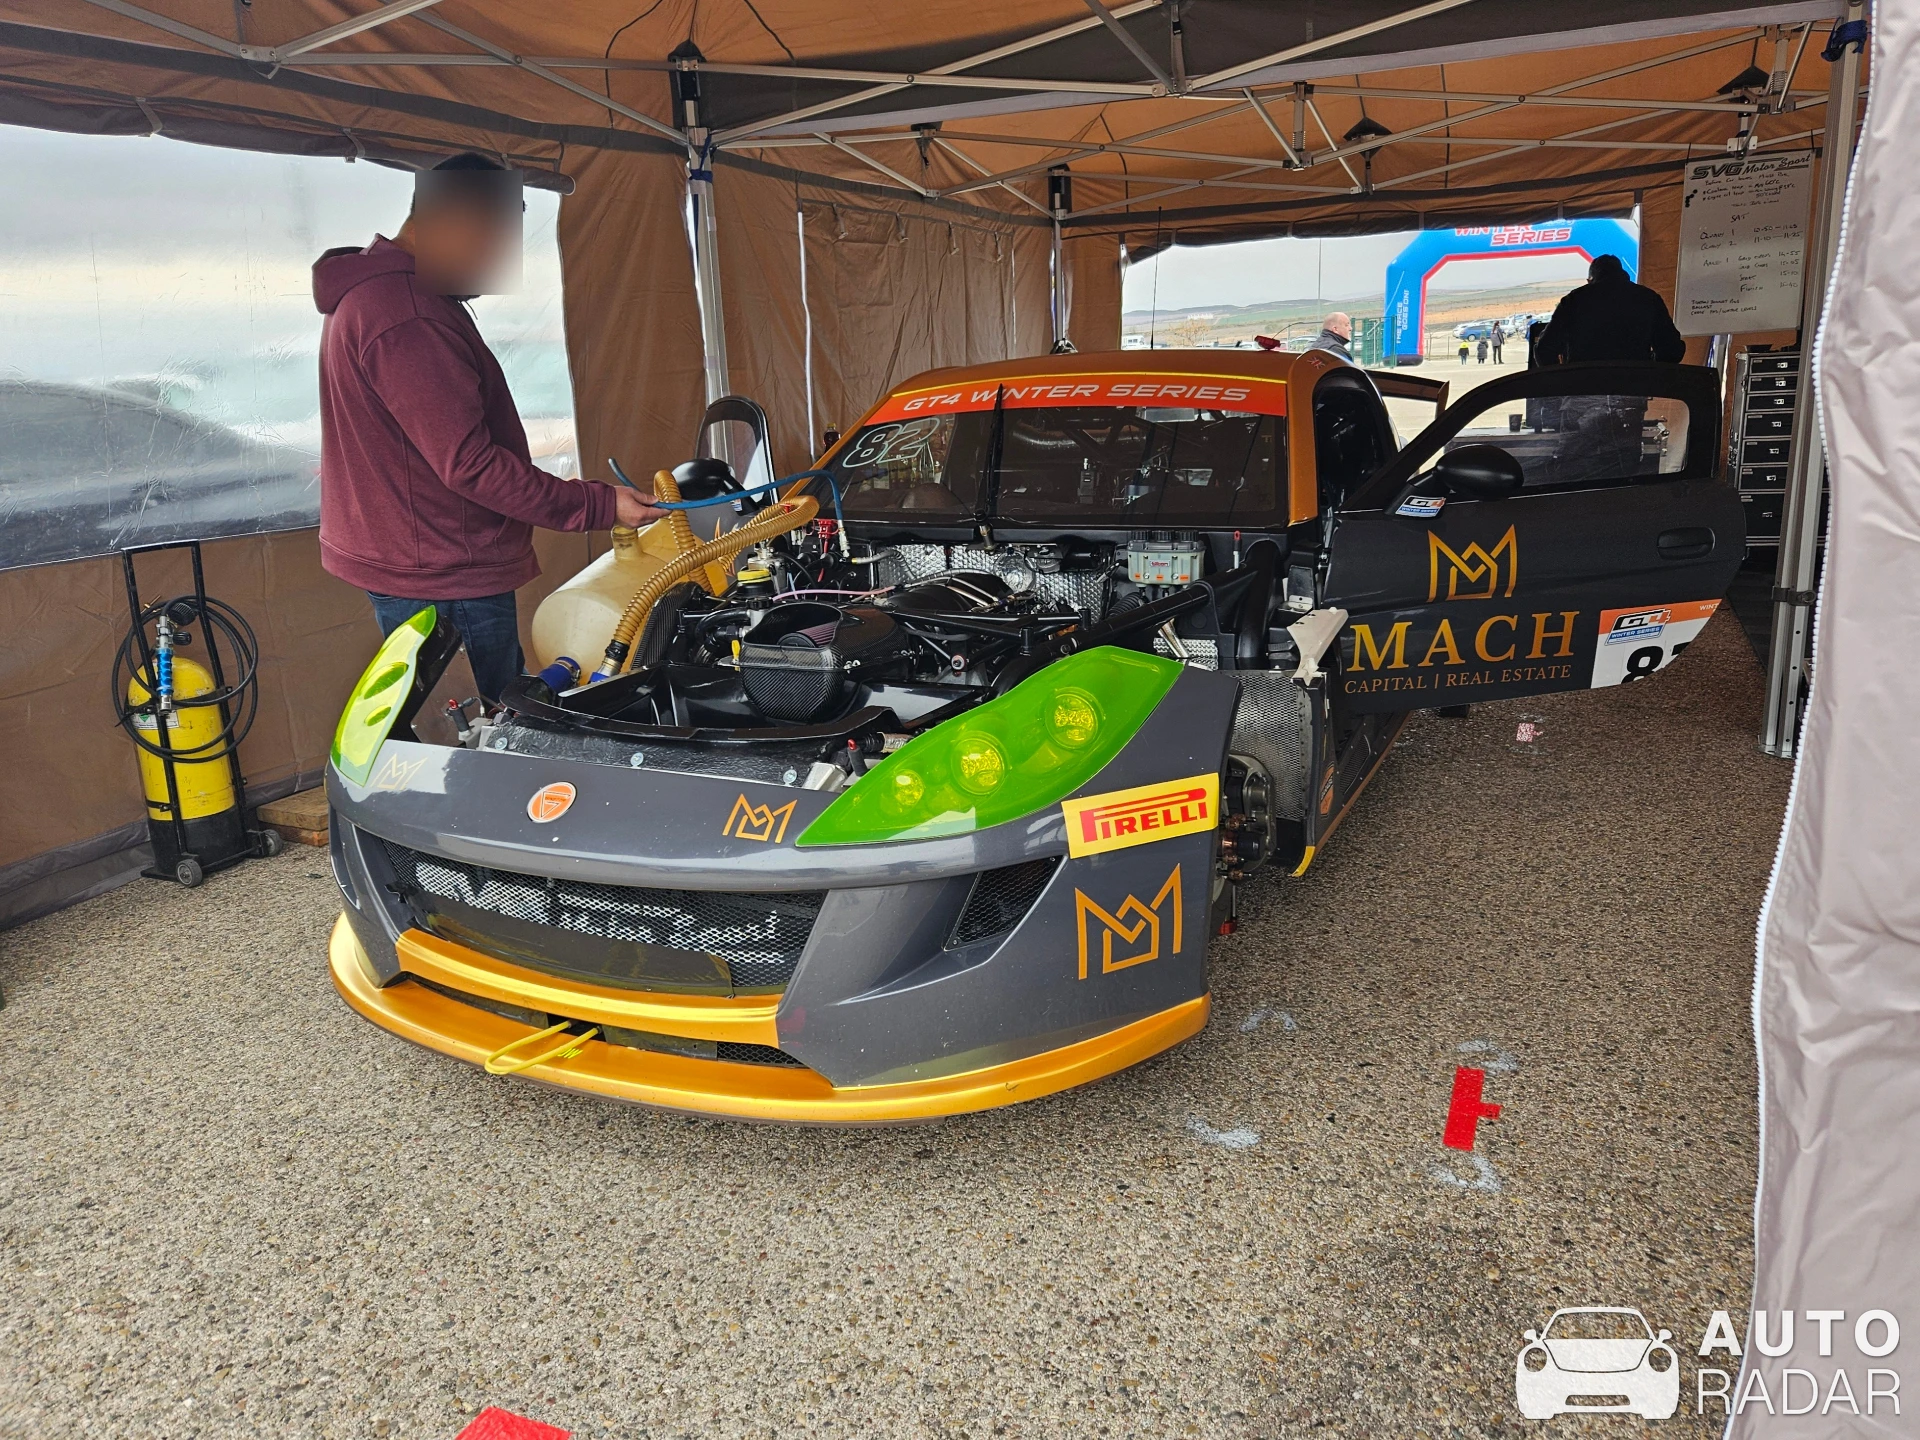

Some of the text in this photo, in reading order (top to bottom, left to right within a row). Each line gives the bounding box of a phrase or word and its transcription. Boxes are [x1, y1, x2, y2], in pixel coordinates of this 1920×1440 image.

[1689, 155, 1810, 180] SVG Motor Sport
[1491, 228, 1572, 246] SERIES
[903, 393, 962, 411] GT4
[1109, 383, 1251, 403] SERIES
[842, 416, 941, 469] 82
[1611, 627, 1661, 638] WINTER SERIES
[1613, 608, 1671, 630] GT4
[1346, 610, 1580, 673] MACH
[1344, 676, 1428, 694] CAPITAL
[1446, 669, 1495, 688] REAL
[1501, 664, 1572, 683] ESTATE
[1079, 787, 1208, 844] PIRELLI
